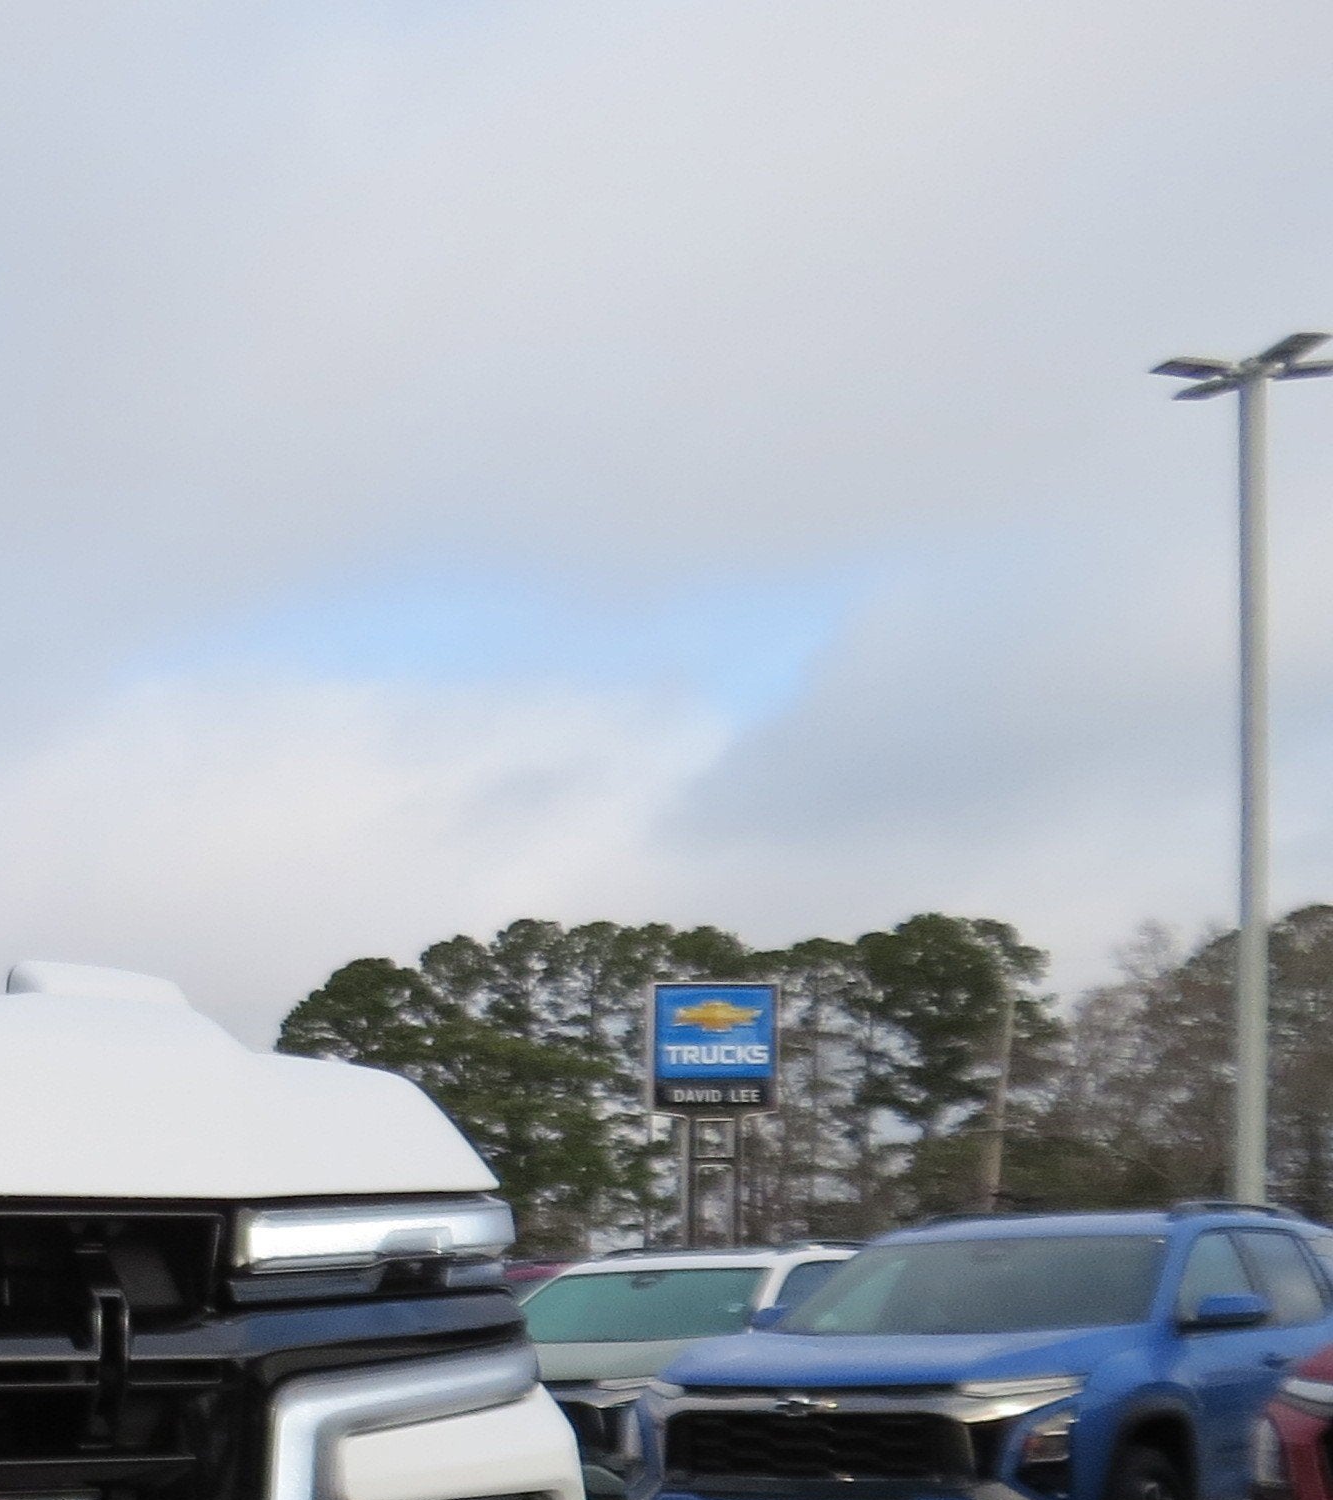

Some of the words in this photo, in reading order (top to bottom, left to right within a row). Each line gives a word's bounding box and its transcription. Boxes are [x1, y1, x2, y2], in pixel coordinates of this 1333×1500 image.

[664, 1044, 771, 1066] TRUCKS
[672, 1088, 722, 1104] DAVID
[730, 1088, 761, 1104] LEE
